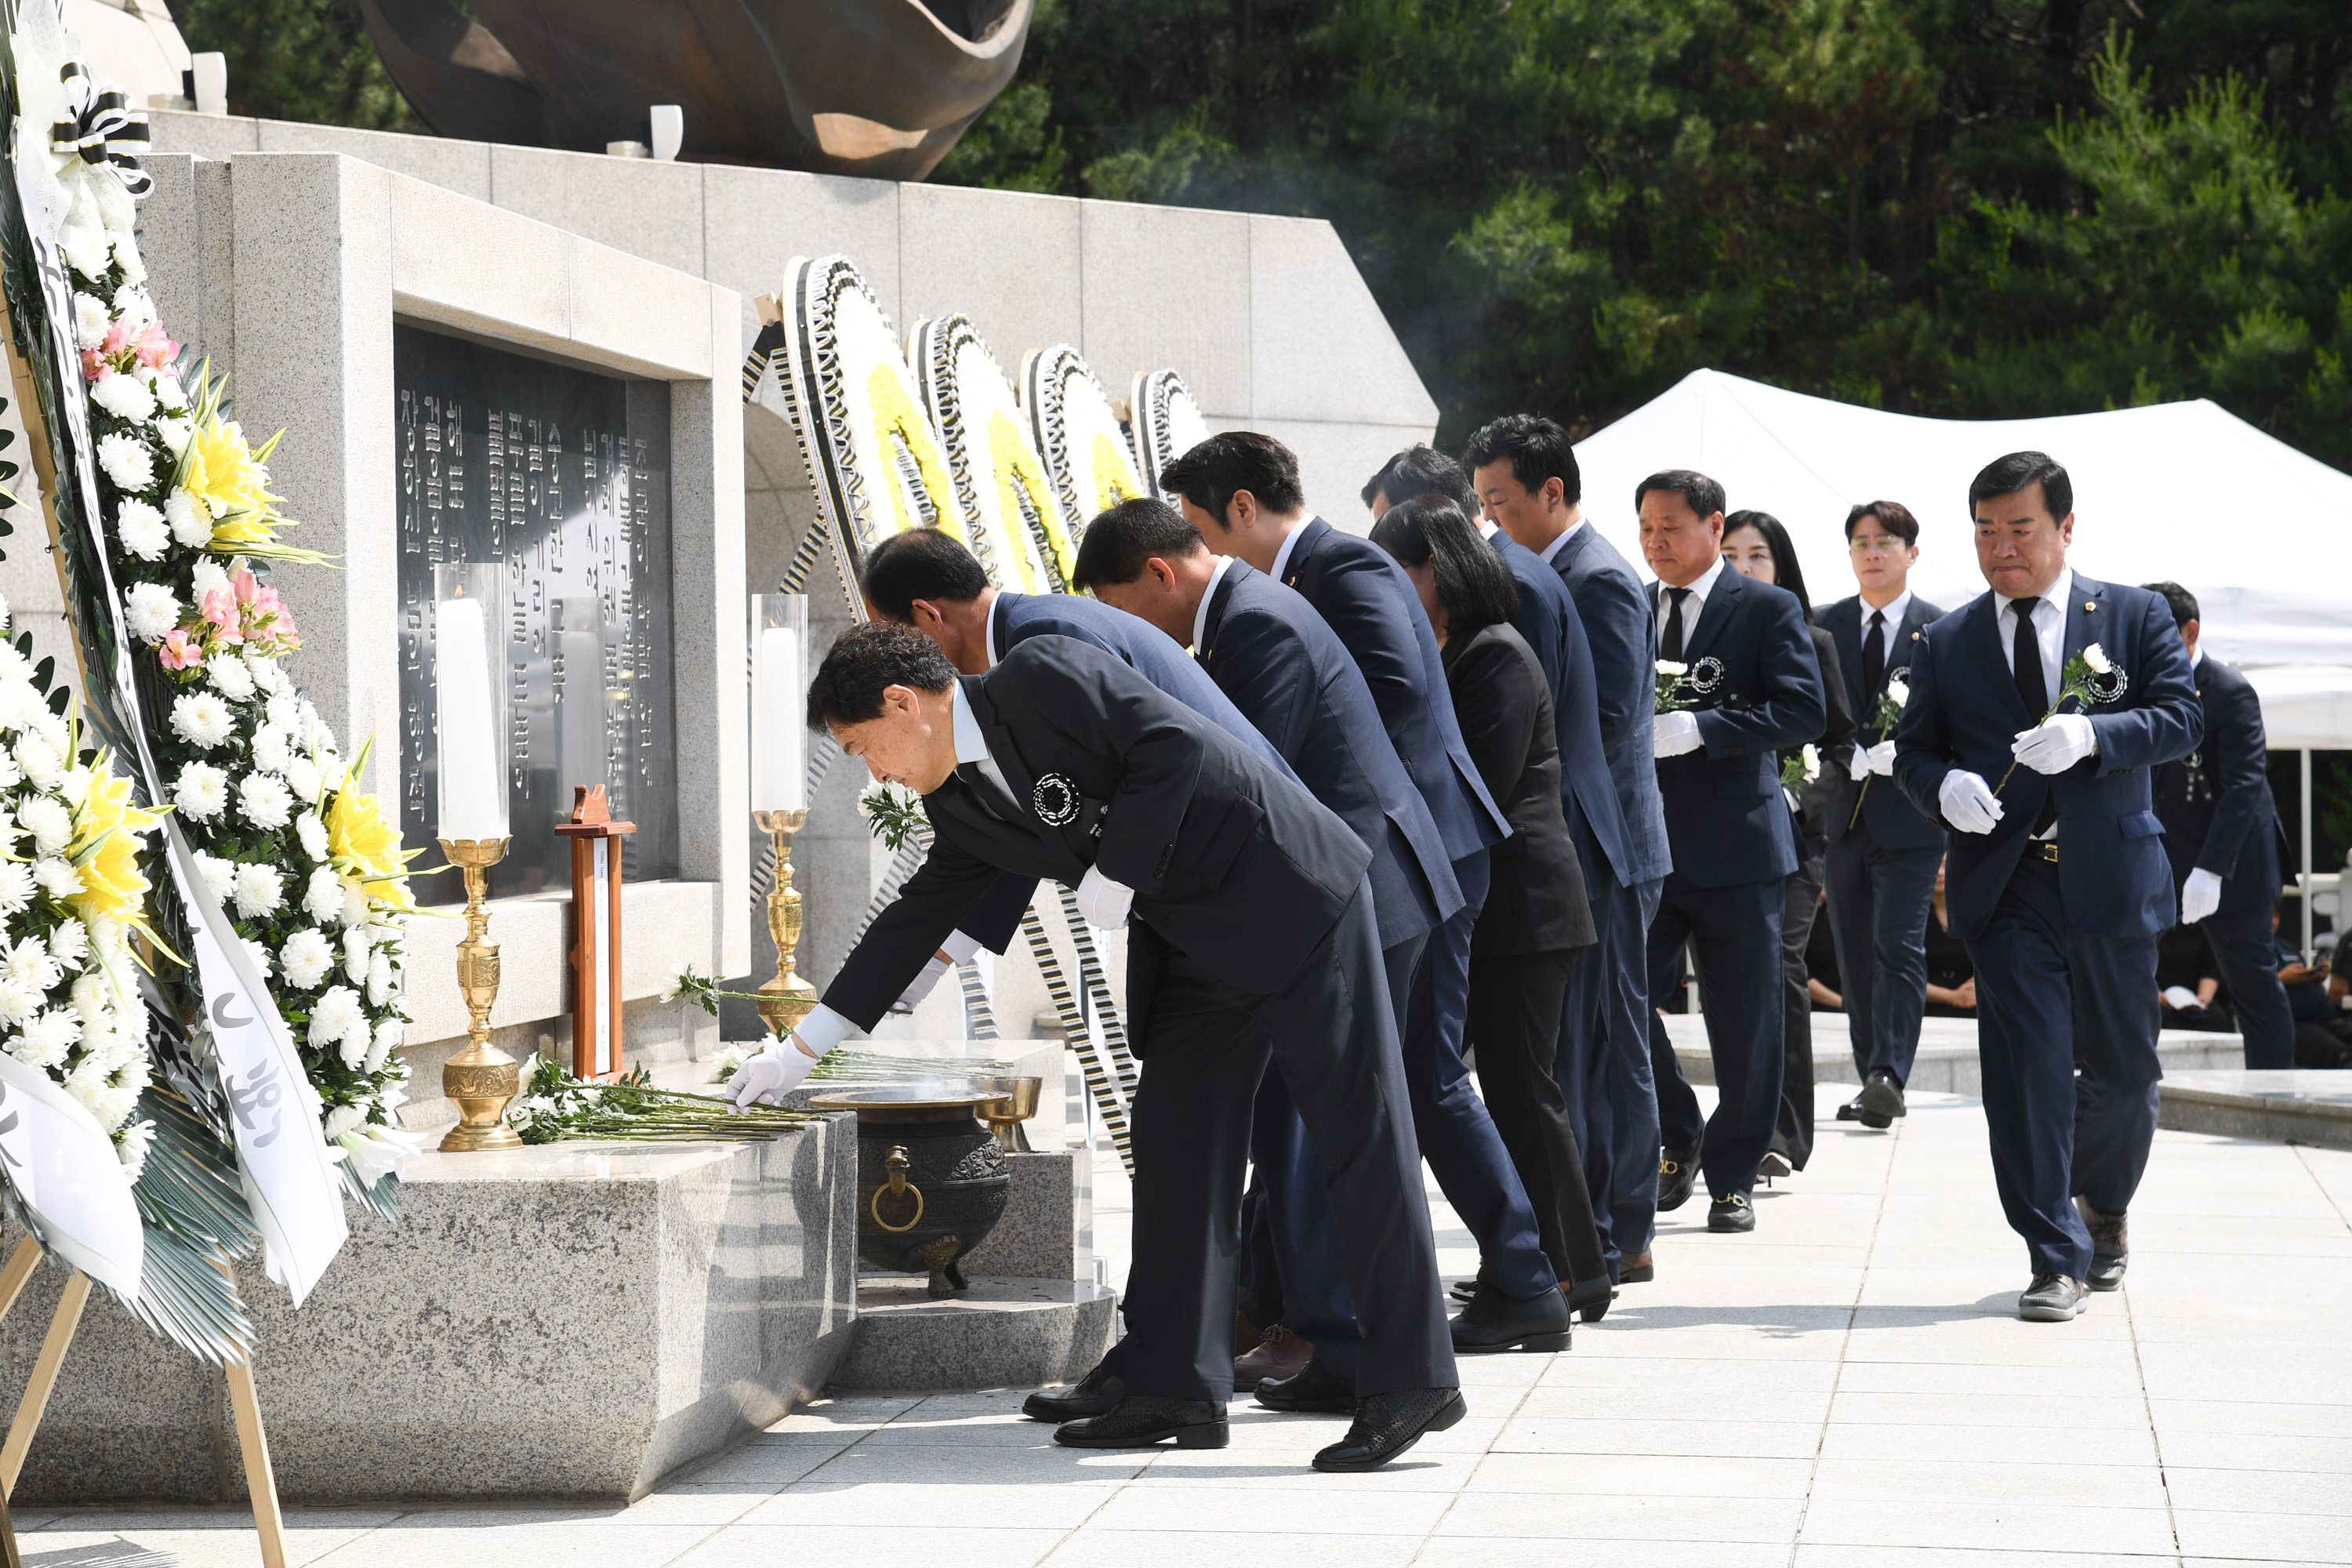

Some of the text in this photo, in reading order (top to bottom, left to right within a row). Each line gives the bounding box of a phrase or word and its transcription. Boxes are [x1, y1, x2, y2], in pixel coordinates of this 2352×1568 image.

[401, 389, 421, 554] 장하신
[528, 419, 546, 662] 길이 기리어
[547, 423, 564, 574] 숭고한
[601, 434, 615, 517] 겨레
[604, 535, 616, 626] 위해
